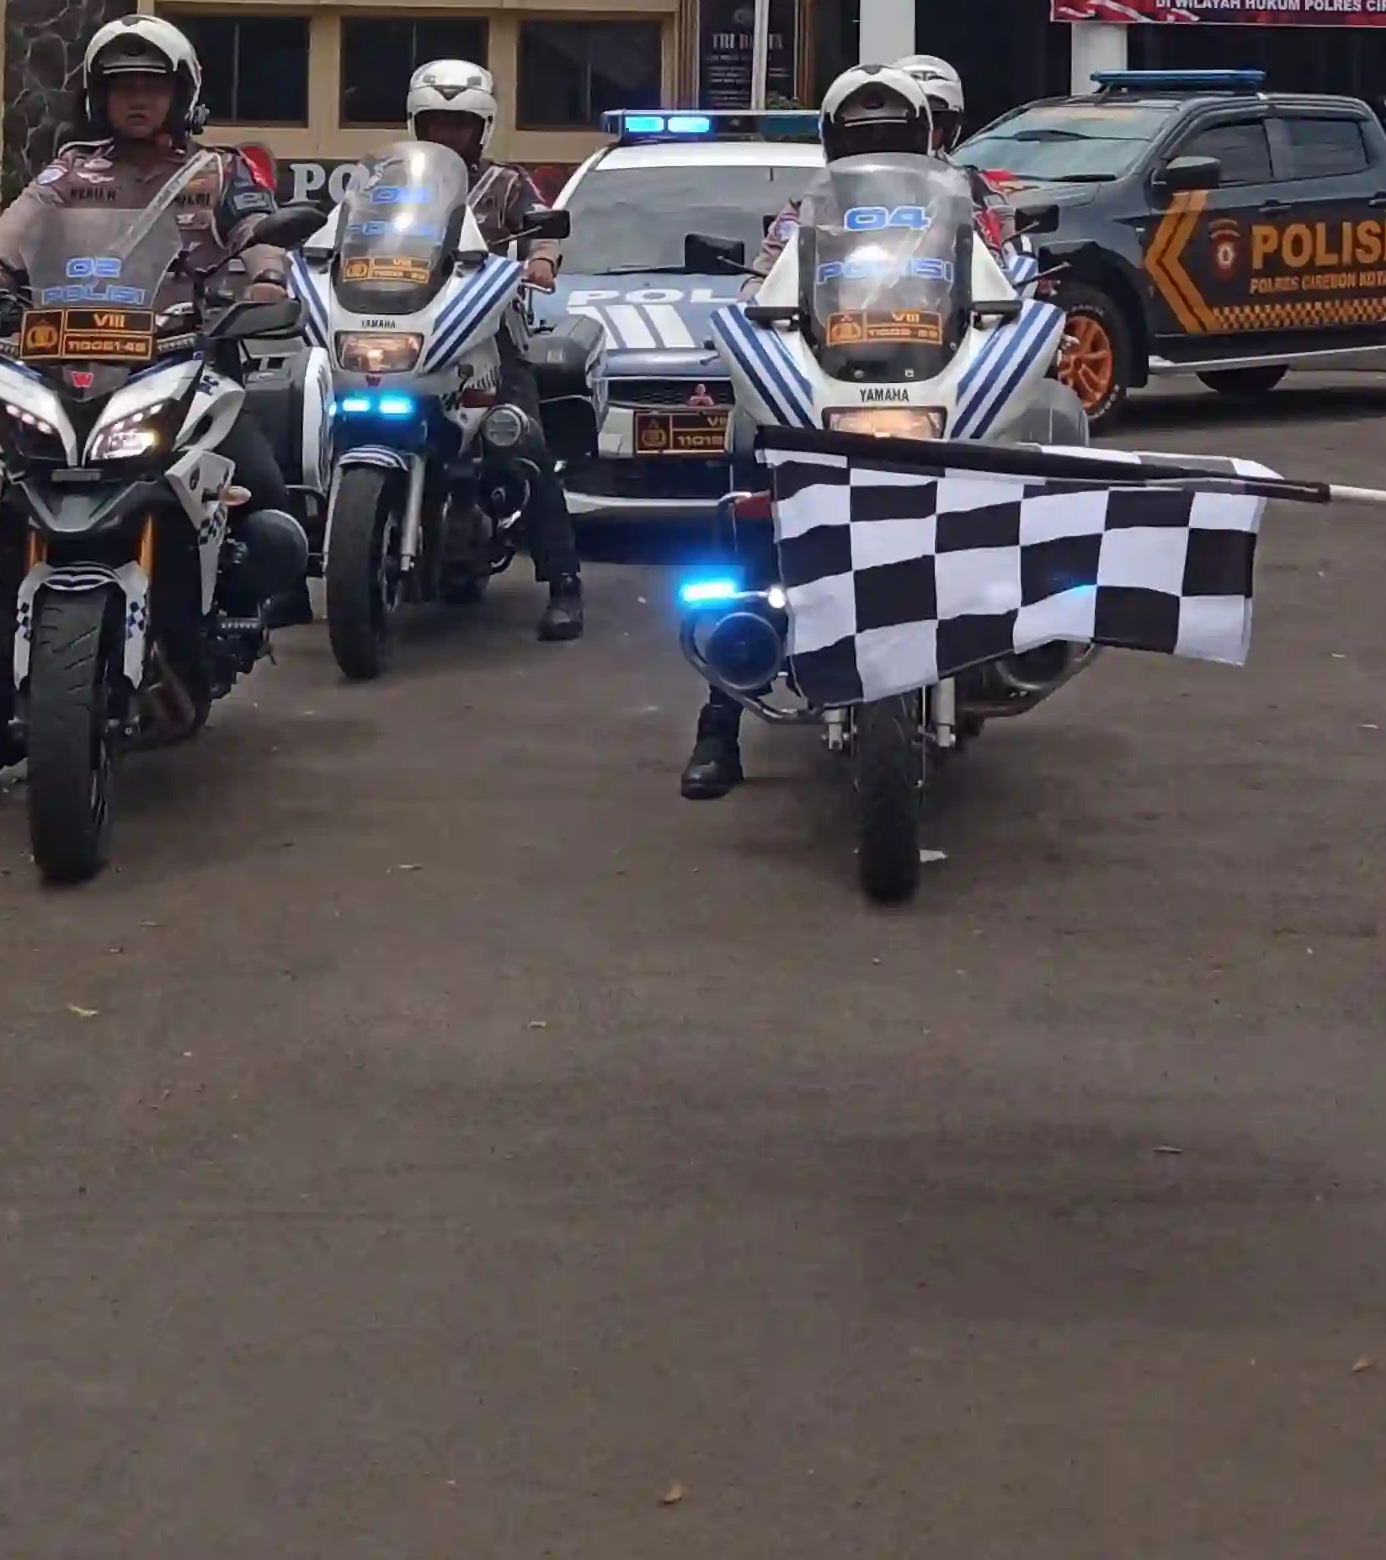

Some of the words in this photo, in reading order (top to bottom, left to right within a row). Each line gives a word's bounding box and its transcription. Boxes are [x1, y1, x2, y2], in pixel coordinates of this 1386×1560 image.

[1304, 0, 1362, 12] POLRES
[844, 206, 932, 231] 04
[1249, 276, 1299, 294] POLRES
[1301, 273, 1356, 291] CIREBON
[42, 284, 146, 306] POLISI
[92, 313, 126, 328] VIII
[361, 319, 396, 330] YAMAHA
[859, 388, 910, 402] YAMAHA
